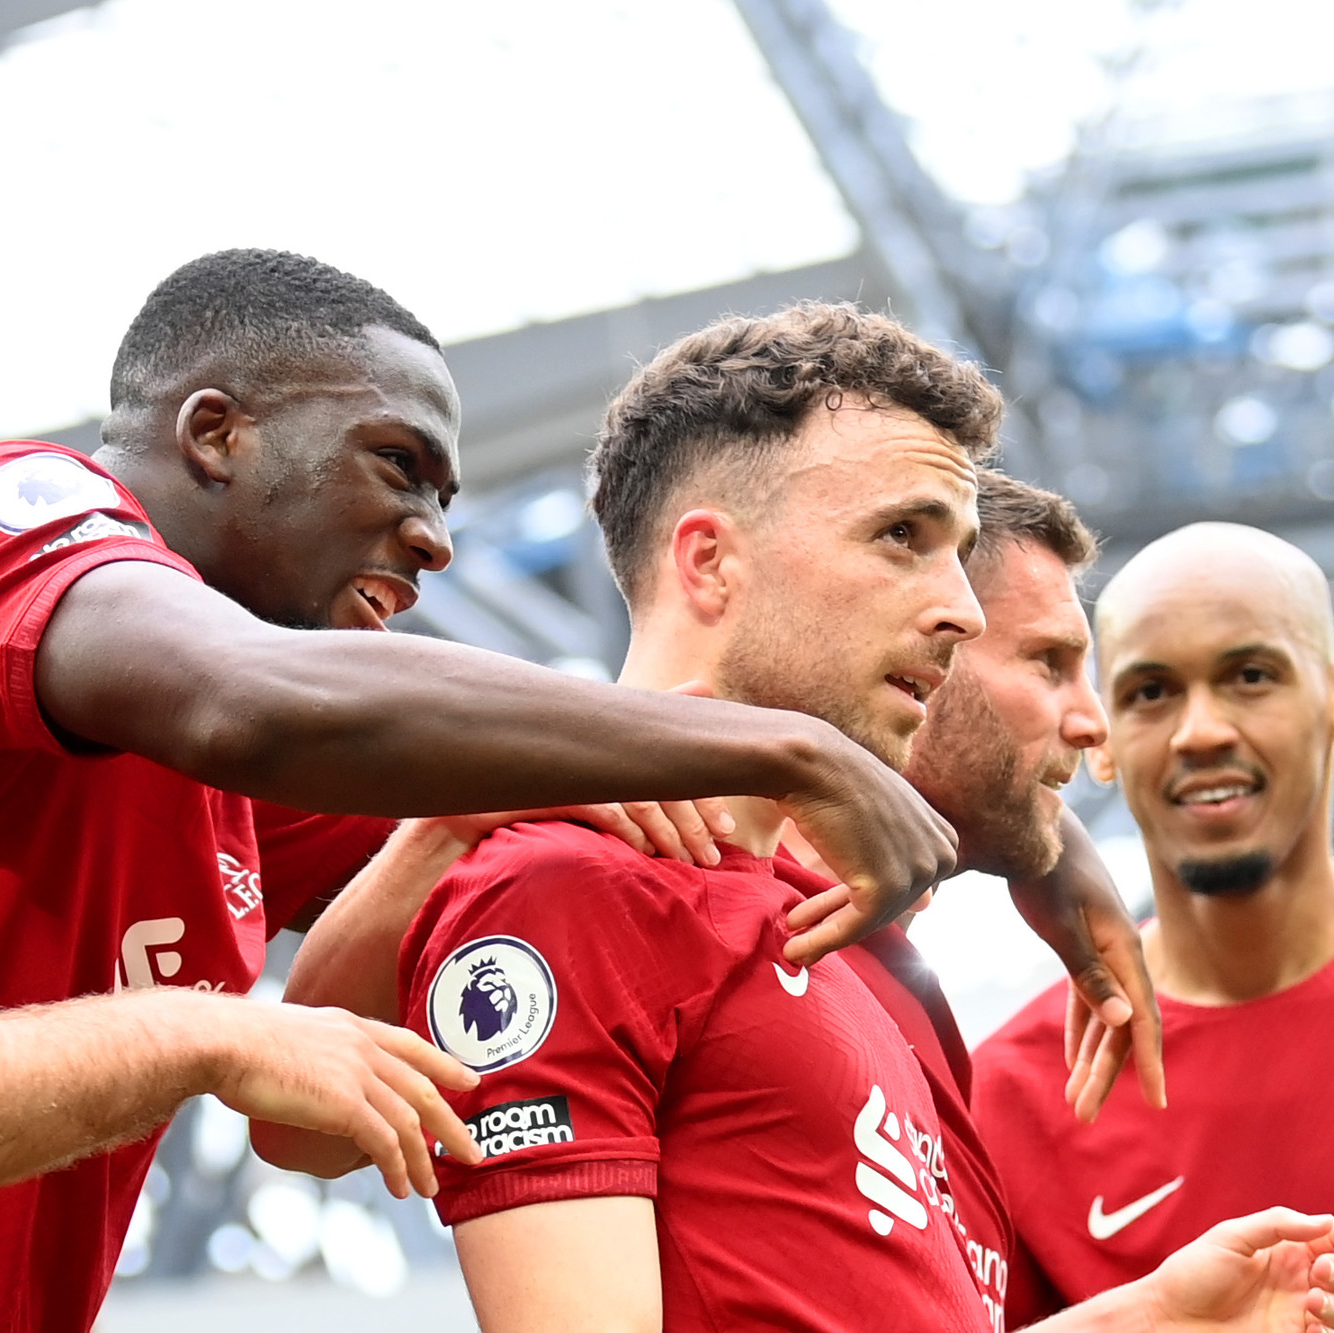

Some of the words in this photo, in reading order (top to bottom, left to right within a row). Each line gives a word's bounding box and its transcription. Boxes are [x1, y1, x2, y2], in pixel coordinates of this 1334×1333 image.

[487, 1033, 523, 1059] Premier
[518, 993, 540, 1035] League
[480, 1103, 556, 1138] room
[480, 1124, 574, 1158] racism
